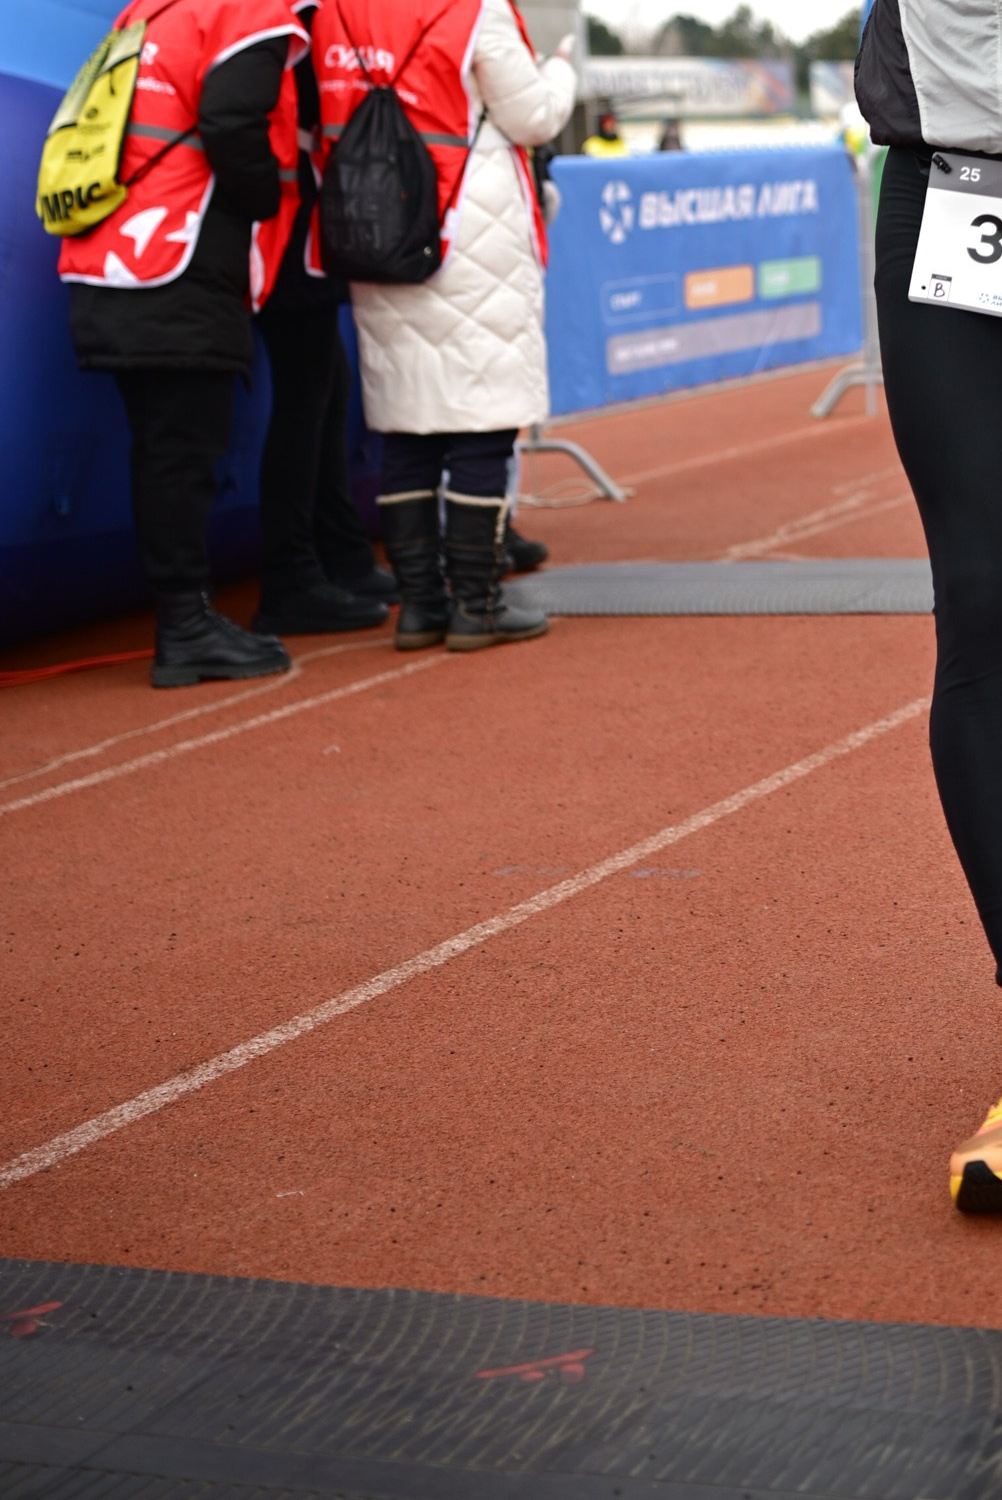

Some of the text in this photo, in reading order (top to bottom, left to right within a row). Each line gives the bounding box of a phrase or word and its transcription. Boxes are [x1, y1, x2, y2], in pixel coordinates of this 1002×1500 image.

[960, 167, 981, 182] 25
[639, 179, 820, 230] ВЫСШАЯ ЛИГА
